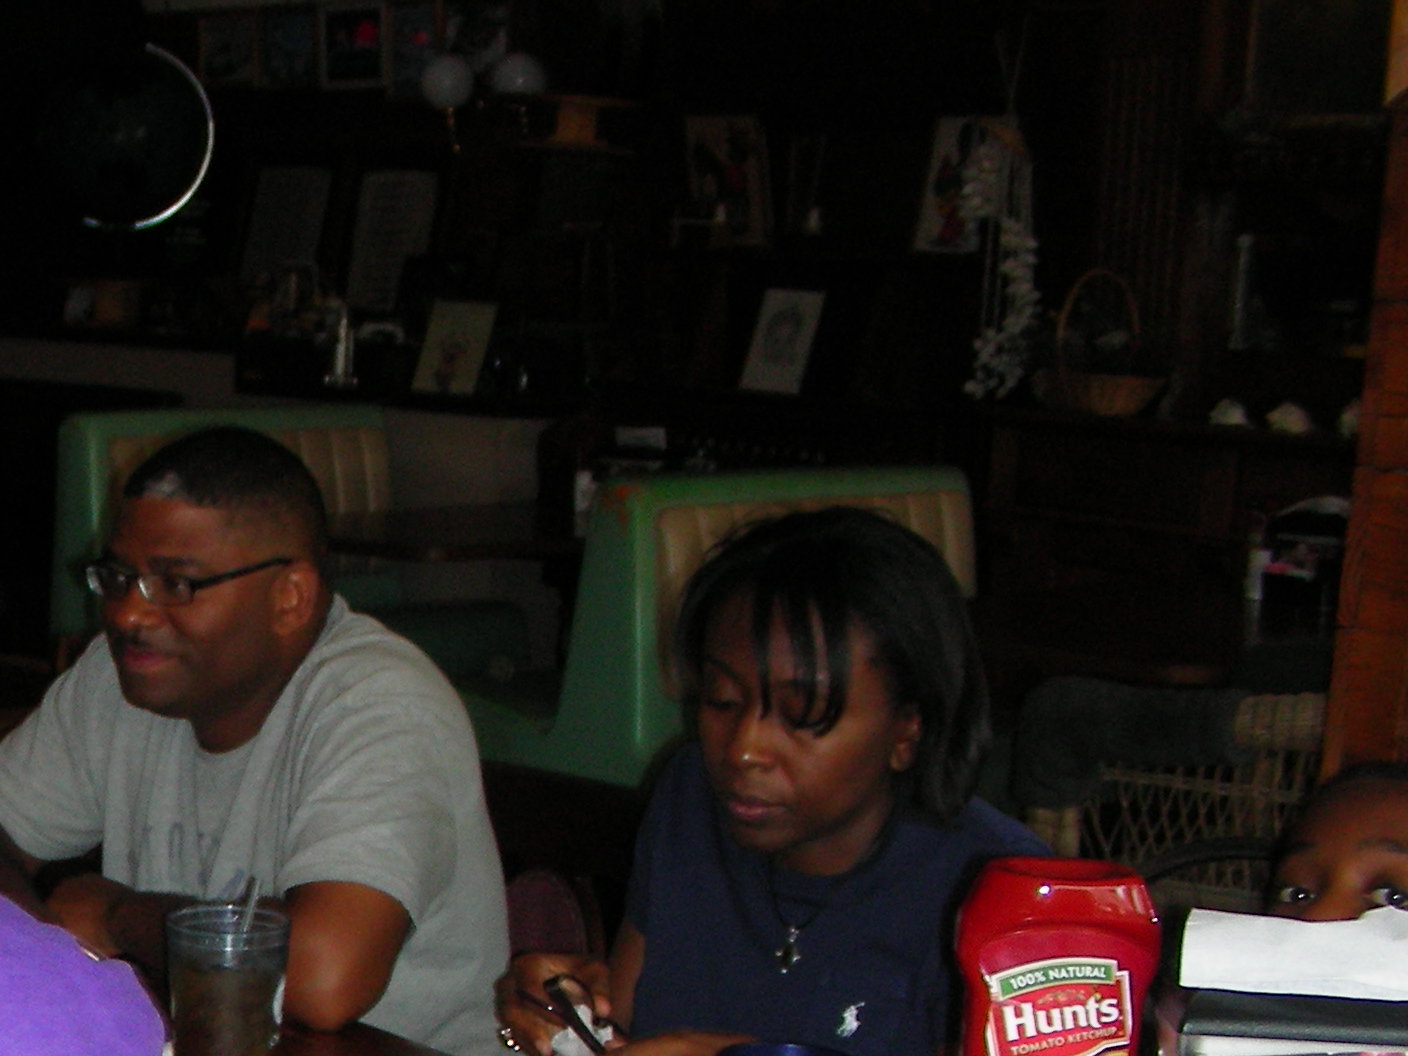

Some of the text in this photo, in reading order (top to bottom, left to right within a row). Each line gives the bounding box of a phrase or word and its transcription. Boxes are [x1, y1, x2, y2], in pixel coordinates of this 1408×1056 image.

[1009, 966, 1106, 990] 100% NATURAL
[1001, 993, 1120, 1042] Hunt's
[1009, 1026, 1118, 1056] TOMATO KETCHUP
